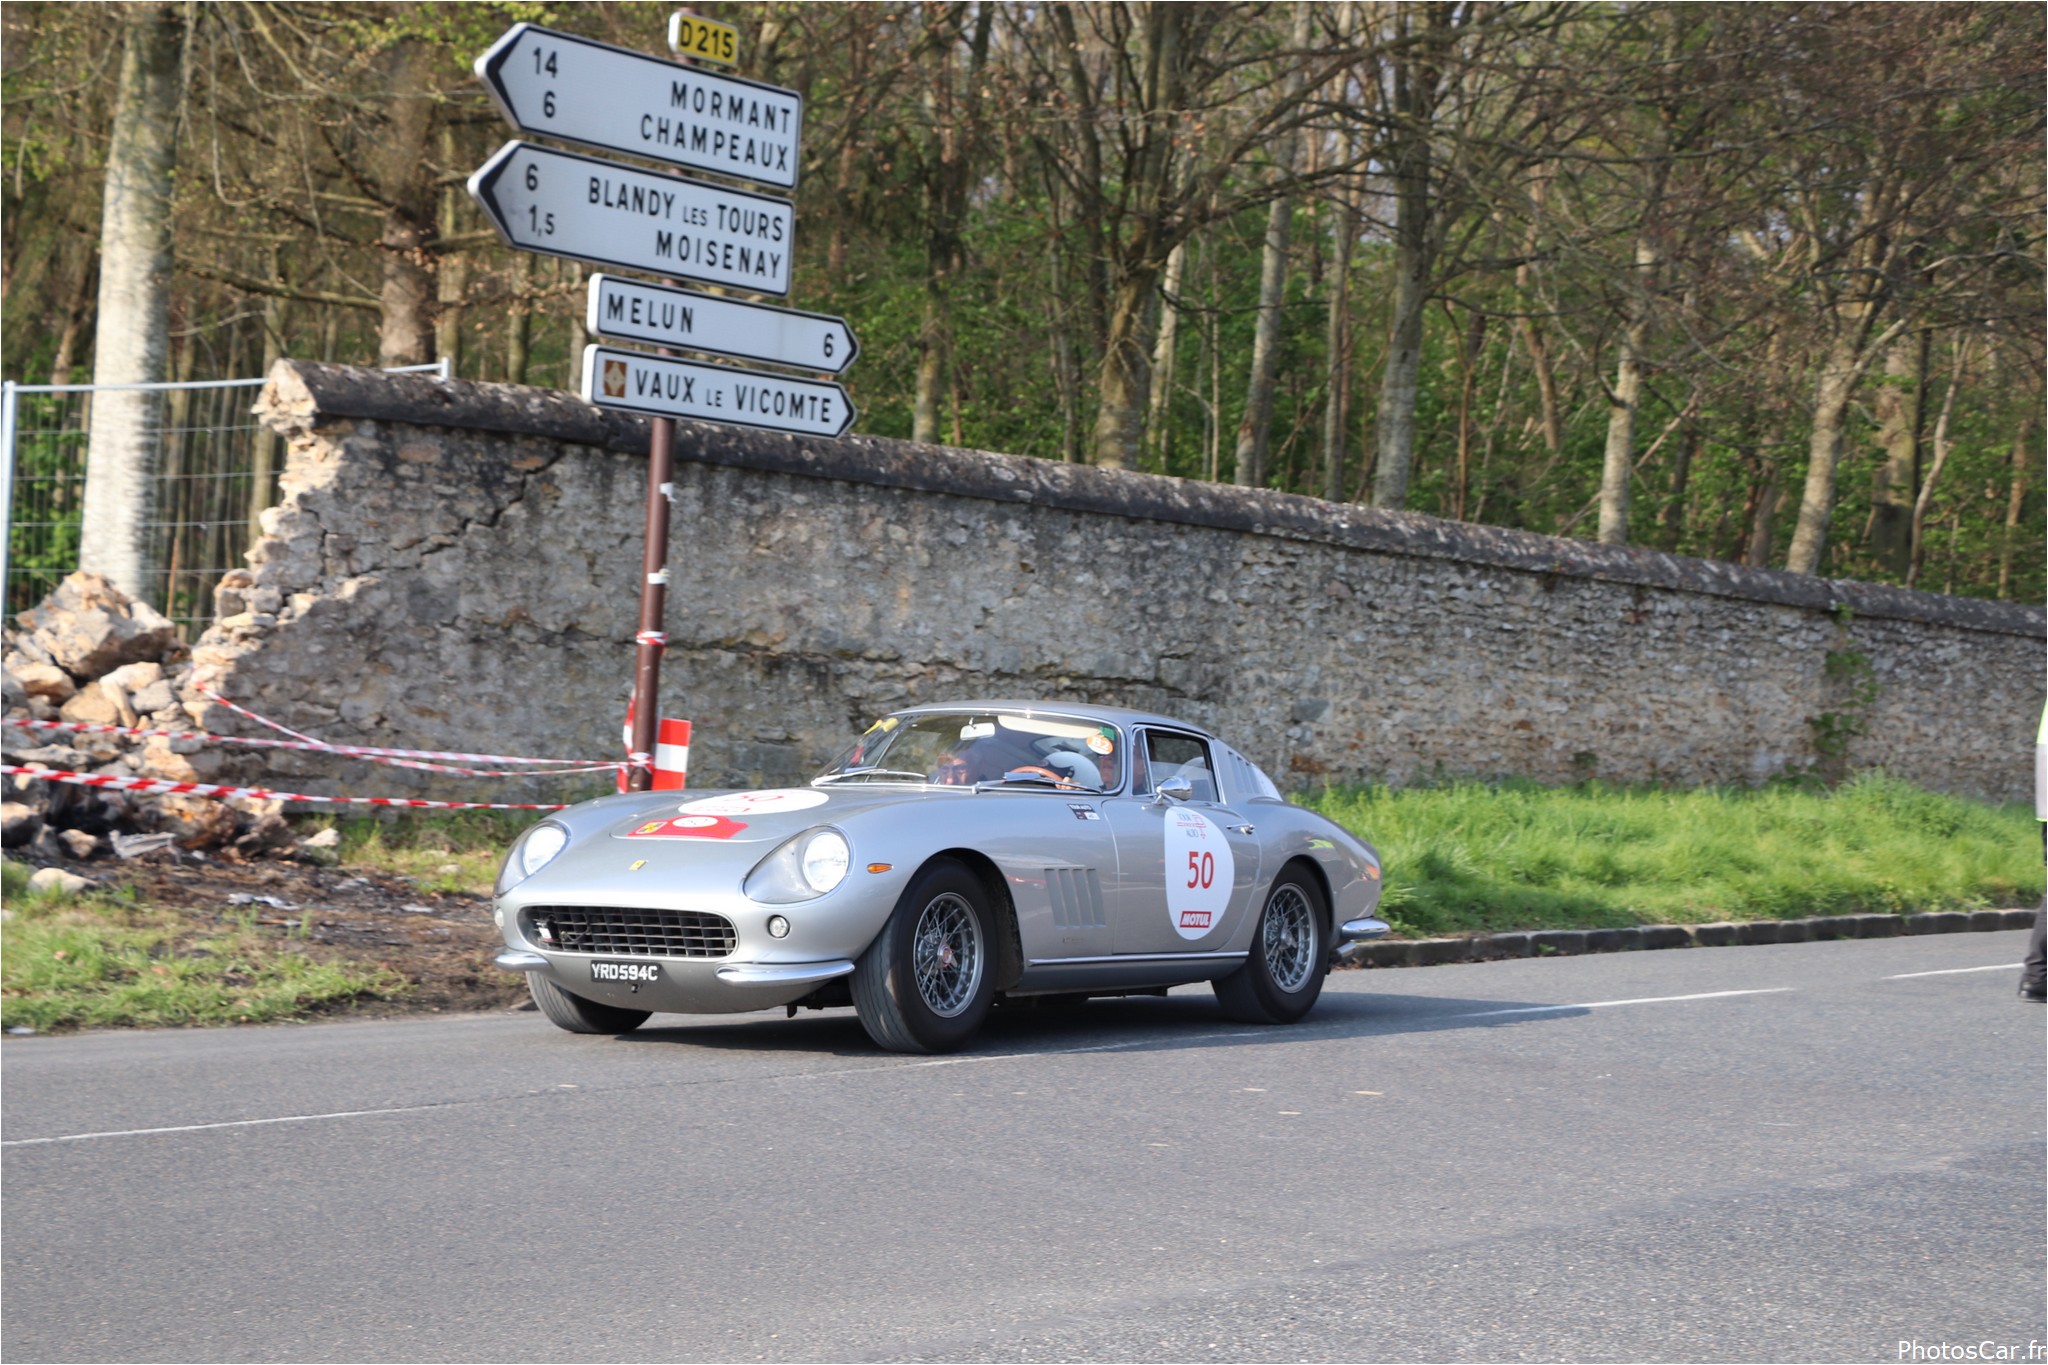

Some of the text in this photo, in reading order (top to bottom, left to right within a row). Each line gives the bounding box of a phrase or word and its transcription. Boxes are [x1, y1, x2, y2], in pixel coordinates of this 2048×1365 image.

[533, 48, 558, 78] 14
[543, 91, 556, 118] 6
[671, 81, 791, 134] MORMANT
[641, 113, 788, 172] CHAMPEAUX
[526, 164, 539, 191] 6
[529, 205, 555, 238] 1,5
[589, 177, 783, 242] BLANDY LES TOURS
[656, 230, 782, 279] MOISENAY
[607, 293, 693, 333] MELUN
[823, 333, 834, 358] 6
[636, 369, 832, 423] VAUX LE VICOMTE
[1187, 851, 1214, 889] 50
[1181, 912, 1210, 927] MOTUL
[591, 963, 658, 981] YRD594C
